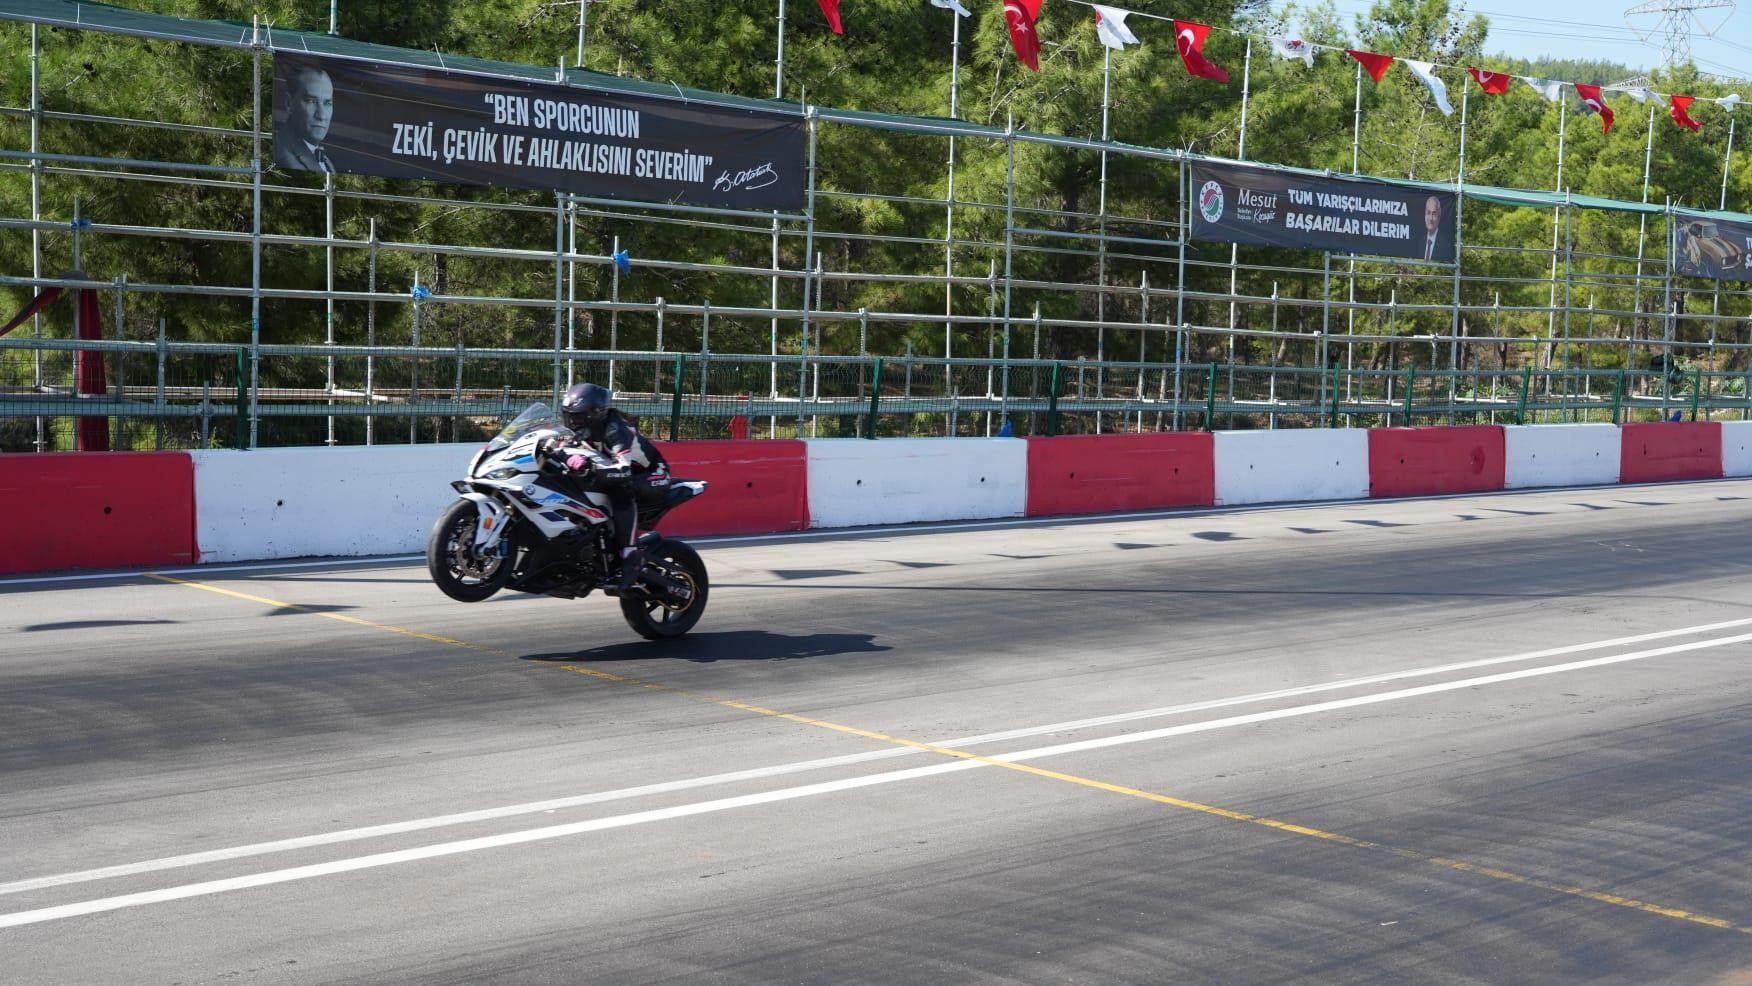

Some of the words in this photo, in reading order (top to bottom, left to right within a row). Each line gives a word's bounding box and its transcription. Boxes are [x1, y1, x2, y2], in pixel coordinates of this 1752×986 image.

[484, 93, 529, 127] “BEN
[533, 98, 640, 139] SPORCUNUN
[392, 121, 438, 161] ZEKİ,
[443, 127, 498, 165] ÇEVİK
[503, 134, 525, 166] VE
[527, 137, 632, 176] AHLAKLISINI
[635, 149, 713, 183] SEVERİM”
[1238, 188, 1277, 208] Mesut
[1316, 192, 1409, 217] YARIŞÇILARIMIZA
[1285, 212, 1360, 233] BAŞARILAR
